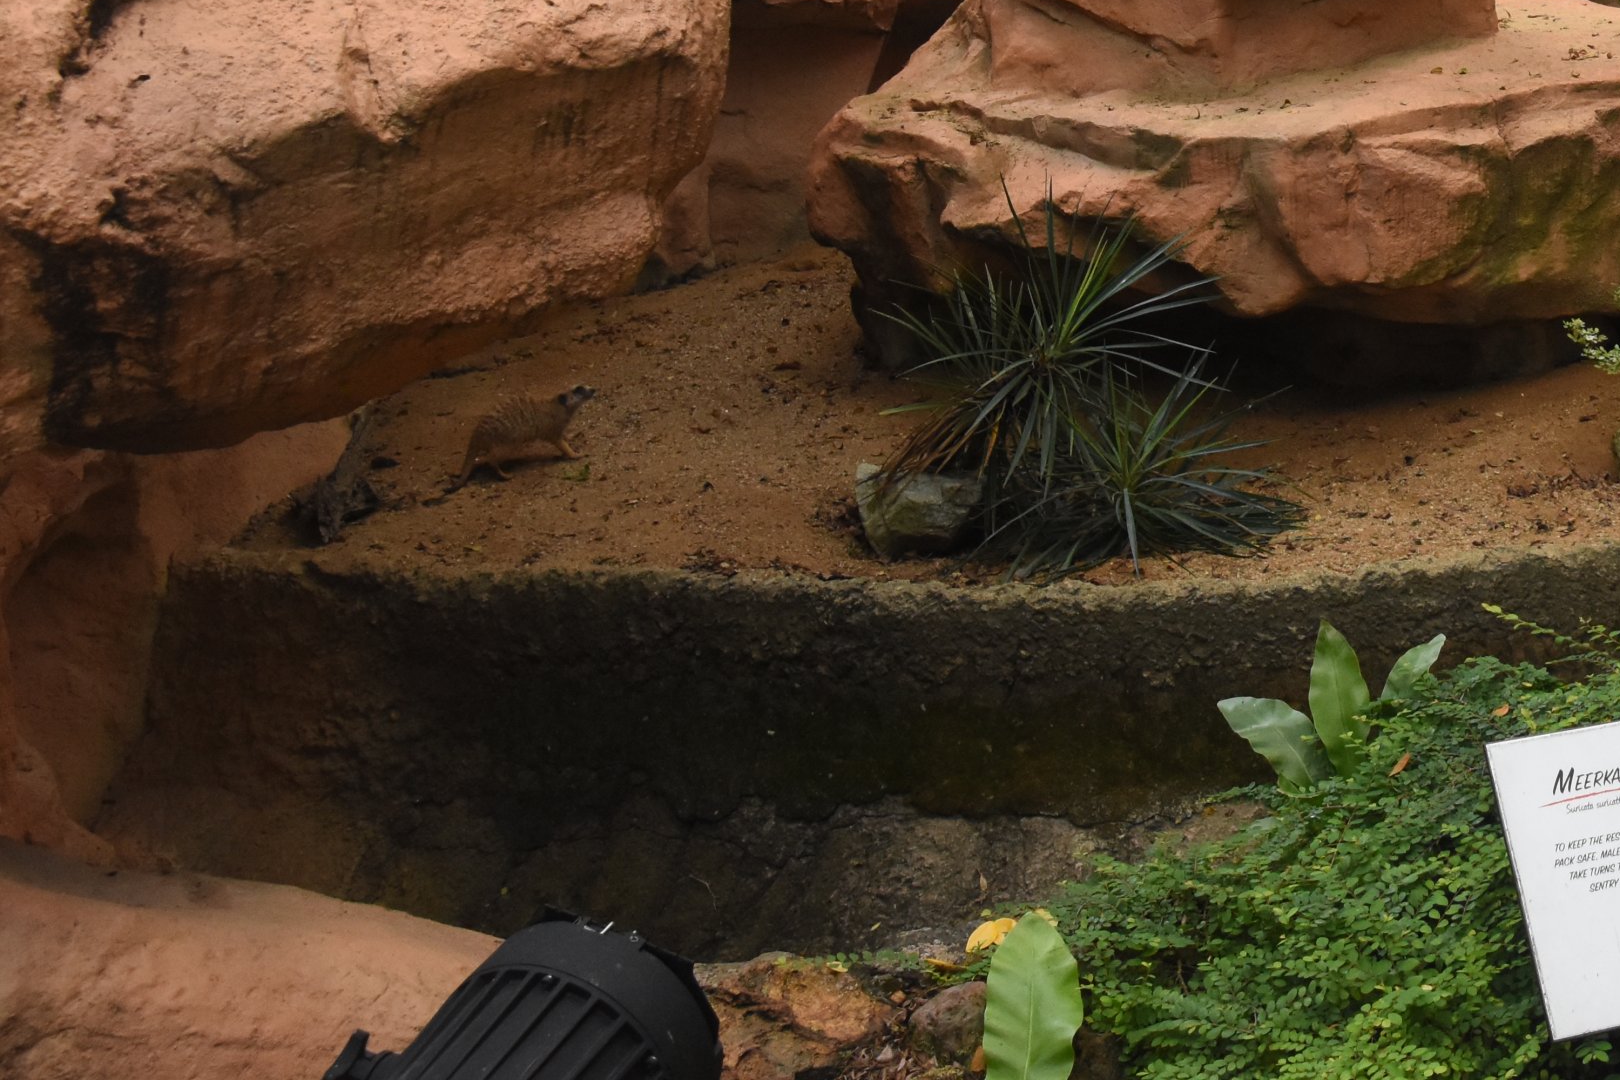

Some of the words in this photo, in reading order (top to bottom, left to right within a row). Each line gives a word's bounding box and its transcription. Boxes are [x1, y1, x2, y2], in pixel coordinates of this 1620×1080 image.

[1566, 802, 1593, 814] Suricata
[1555, 843, 1565, 852] TO
[1568, 838, 1587, 849] KEEP
[1590, 834, 1603, 846] THE
[1554, 856, 1575, 868] PACK
[1600, 847, 1620, 859] MALE
[1569, 869, 1588, 880] TAKE
[1590, 864, 1615, 877] TURNS
[1589, 878, 1619, 892] SENTRY
